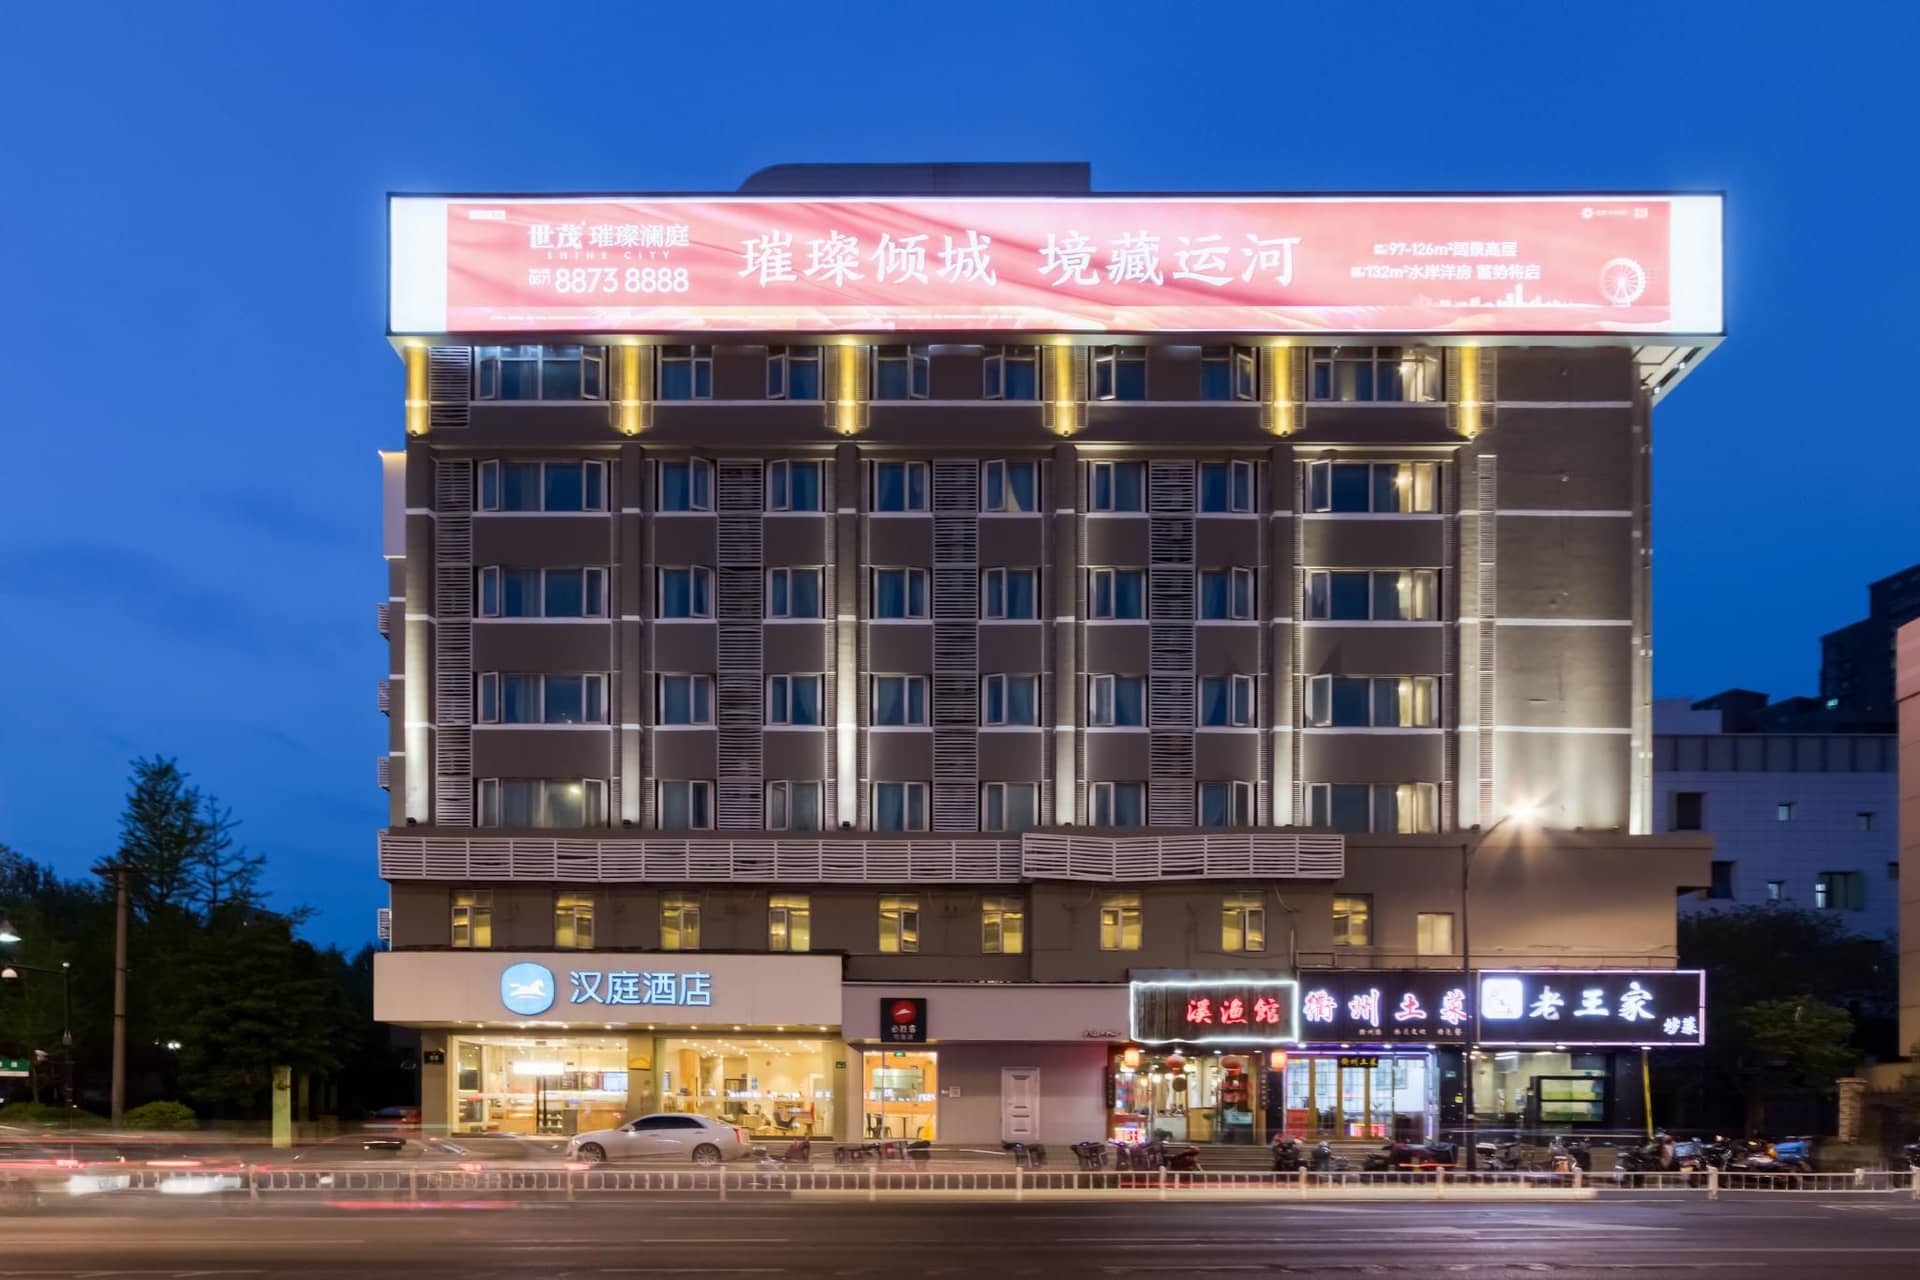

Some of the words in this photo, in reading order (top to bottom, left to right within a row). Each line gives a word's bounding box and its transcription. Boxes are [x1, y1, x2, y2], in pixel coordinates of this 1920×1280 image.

[528, 224, 583, 250] 世茂
[590, 223, 689, 248] 璀璨澜庭
[623, 251, 671, 260] CITY
[738, 229, 998, 288] 璀璨倾城
[1039, 230, 1302, 287] 境藏运河
[555, 267, 619, 293] 8873
[624, 267, 689, 293] 8888
[569, 970, 712, 1007] 汉庭酒店
[1529, 981, 1656, 1022] 老王家
